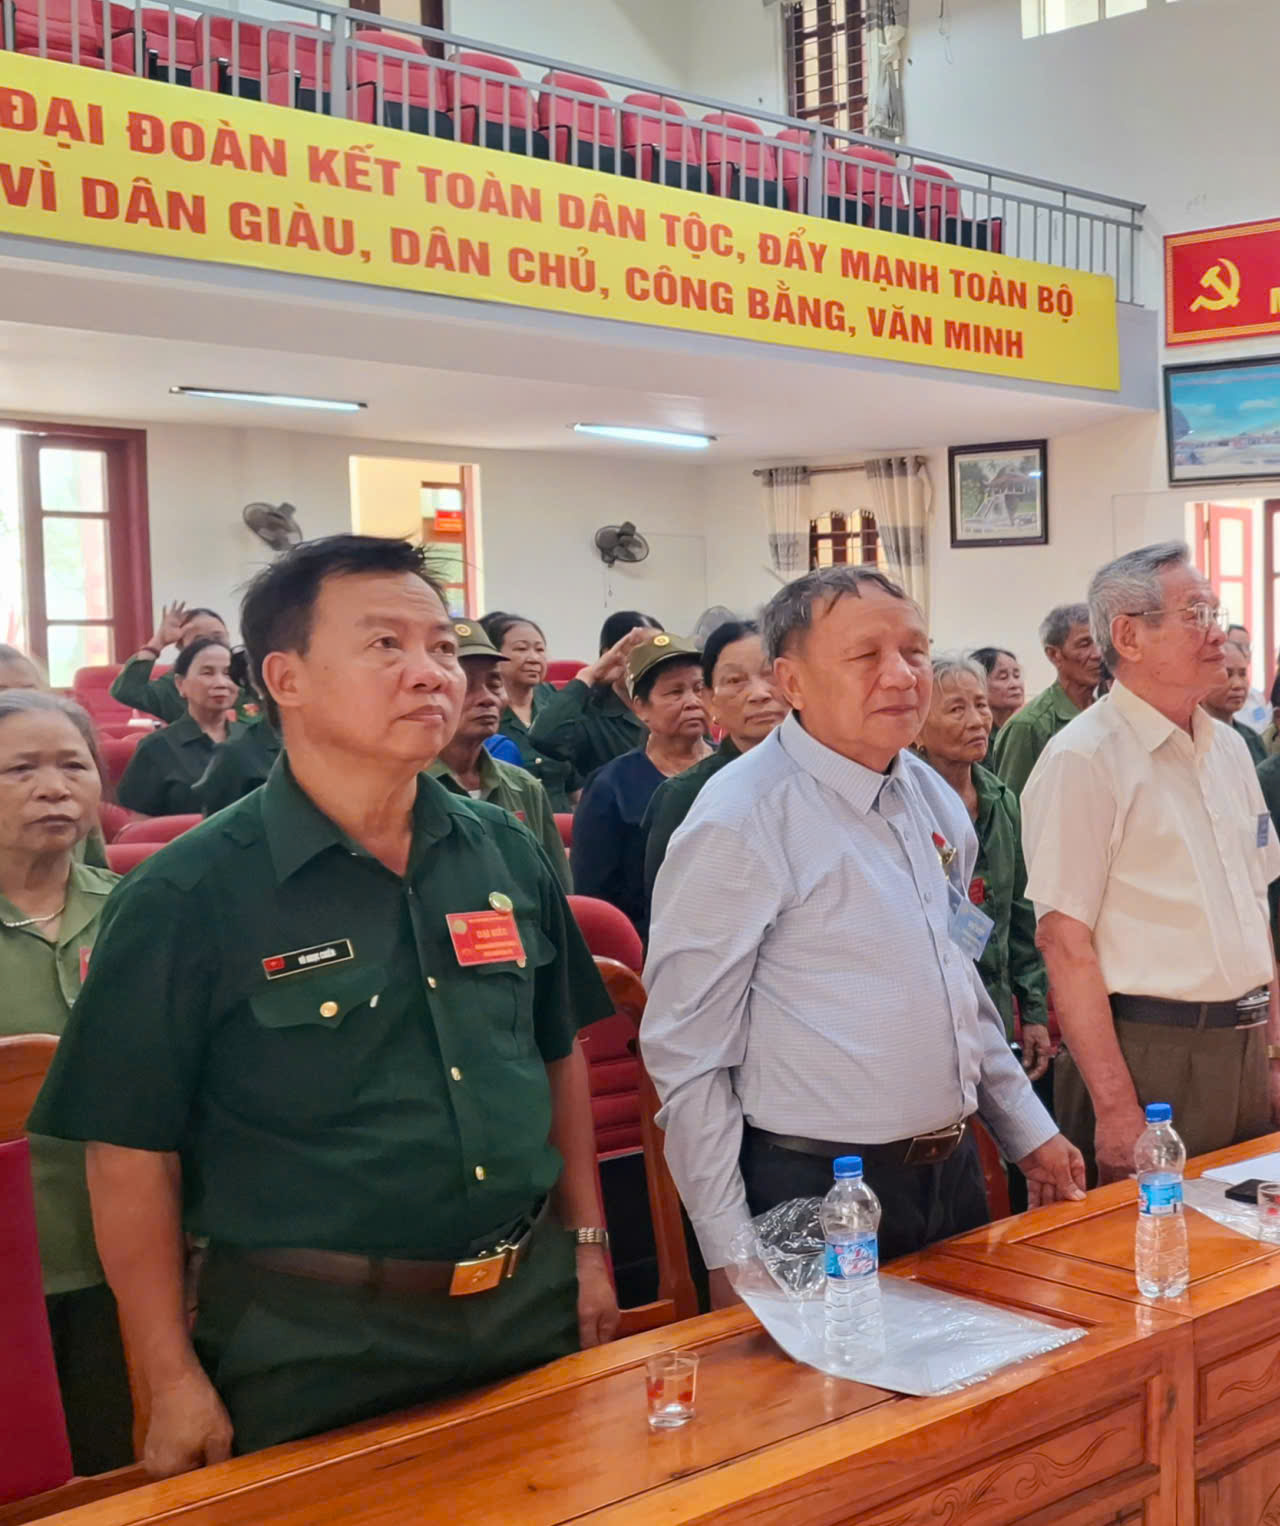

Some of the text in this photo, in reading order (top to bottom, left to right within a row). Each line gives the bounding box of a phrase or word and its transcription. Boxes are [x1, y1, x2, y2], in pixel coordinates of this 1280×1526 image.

[0, 87, 1074, 323] ĐẠI ĐOÀN KẾT TOÀN DÂN TỘC, ĐẨY MẠNH TOÀN BỘ
[0, 161, 1024, 359] VÌ DÂN GIÀU, DÂN CHỦ, CÔNG BẰNG, VĂN MINH
